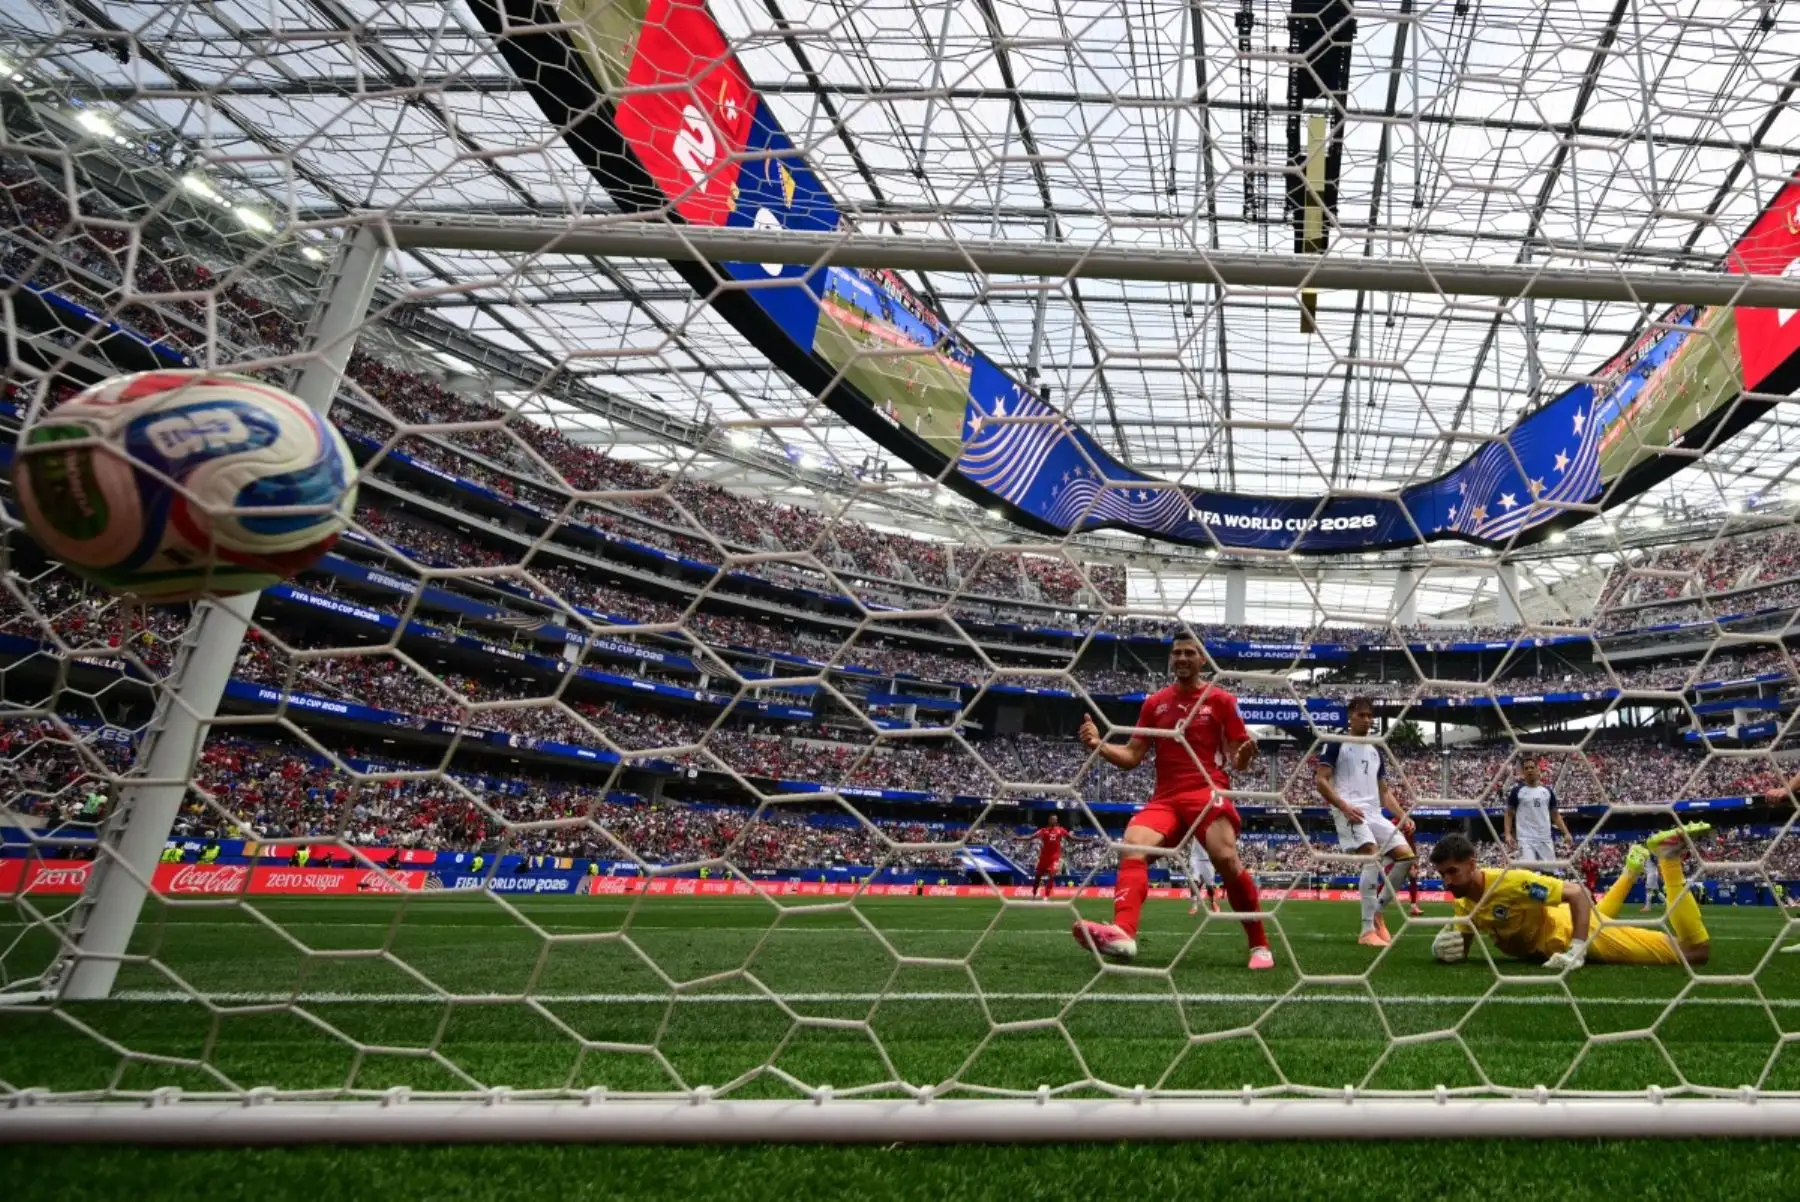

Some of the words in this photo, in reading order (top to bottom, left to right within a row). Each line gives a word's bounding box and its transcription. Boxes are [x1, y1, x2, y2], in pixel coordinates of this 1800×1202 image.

[1188, 509, 1222, 526] FIFA
[1224, 514, 1283, 531] WORLD
[1285, 518, 1318, 531] CUP
[1320, 514, 1377, 531] 2026
[565, 632, 583, 644] FIFA
[617, 644, 635, 655] CUP
[1276, 710, 1298, 721] CUP
[1361, 759, 1369, 775] 7
[35, 868, 86, 885] zero
[266, 873, 302, 888] zero
[302, 874, 344, 891] sugar
[455, 877, 477, 889] FIFA
[516, 877, 536, 890] CUP
[536, 878, 569, 891] 2026
